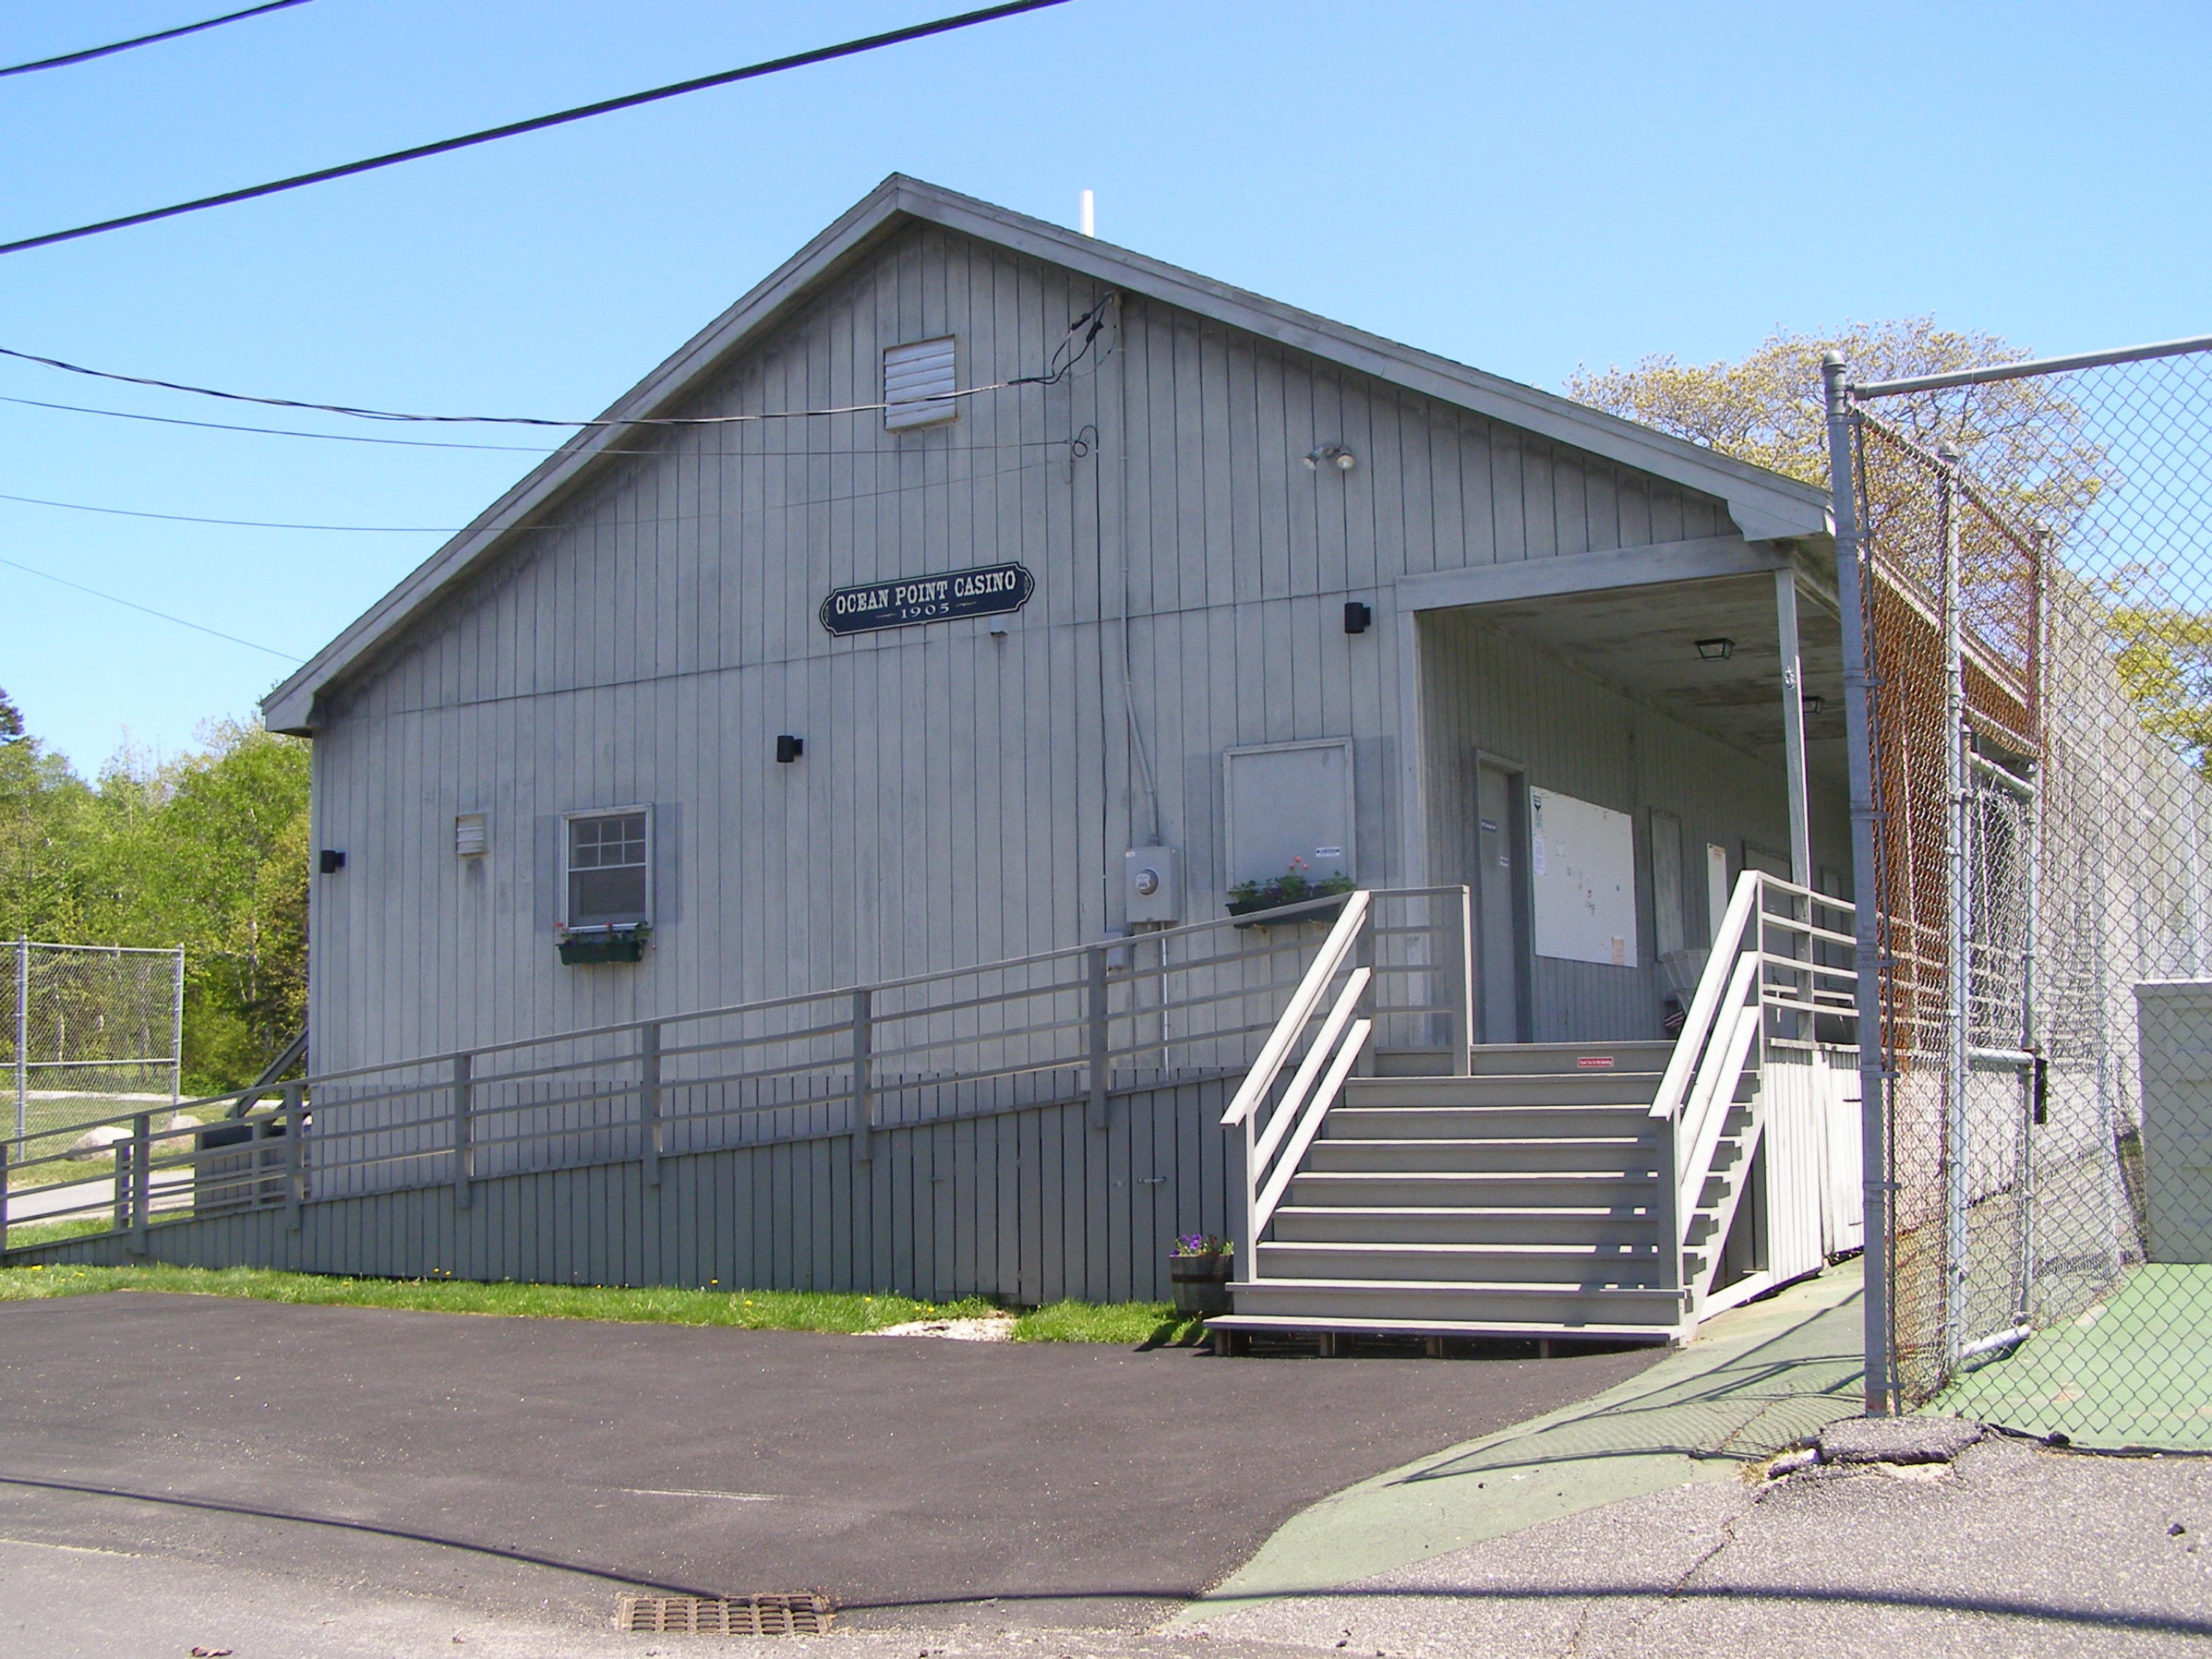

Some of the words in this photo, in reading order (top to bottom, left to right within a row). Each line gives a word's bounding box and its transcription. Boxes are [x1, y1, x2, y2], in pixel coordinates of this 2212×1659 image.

[835, 588, 889, 614] OCEAN
[895, 580, 947, 606] POINT
[954, 570, 1016, 598] CASINO
[901, 602, 950, 619] 1905
